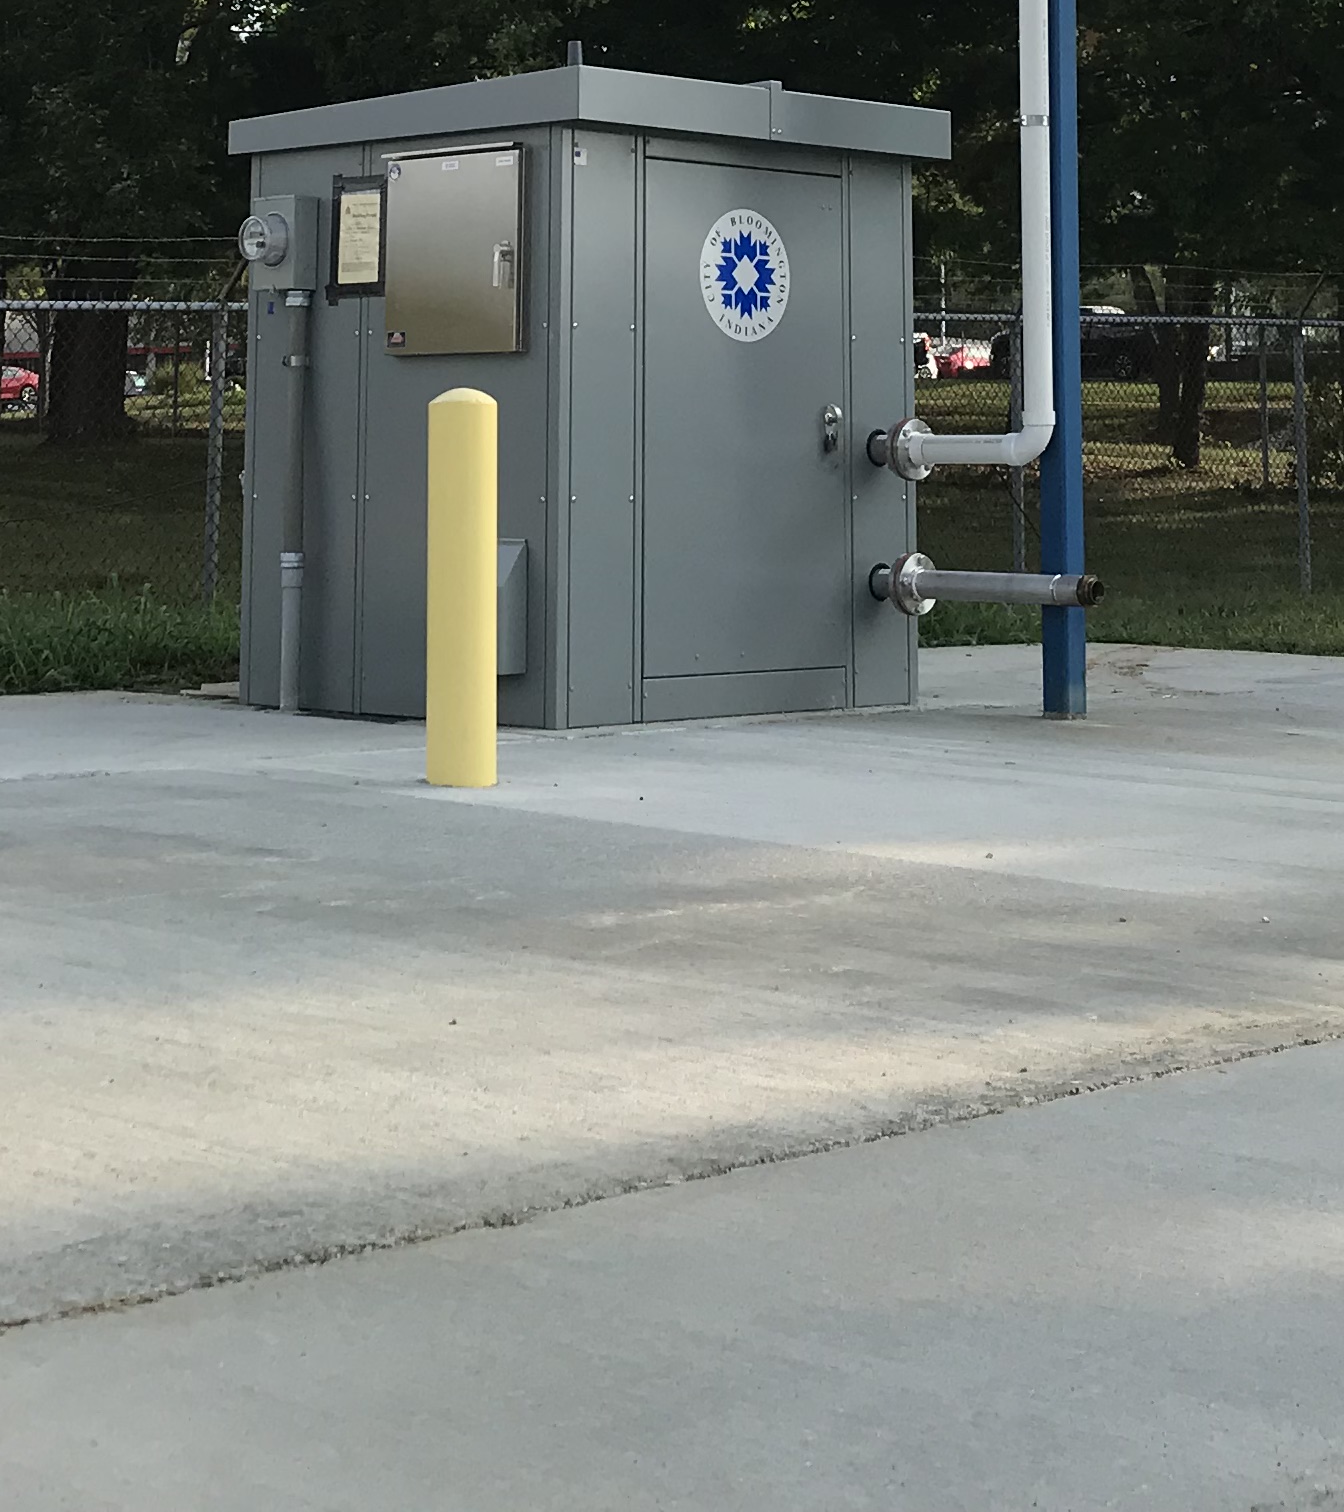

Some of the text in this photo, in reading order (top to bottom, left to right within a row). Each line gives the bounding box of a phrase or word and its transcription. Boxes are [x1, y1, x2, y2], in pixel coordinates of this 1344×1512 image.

[703, 215, 786, 304] CITY OF BLOOMINGTON
[718, 314, 774, 336] INDIANA
